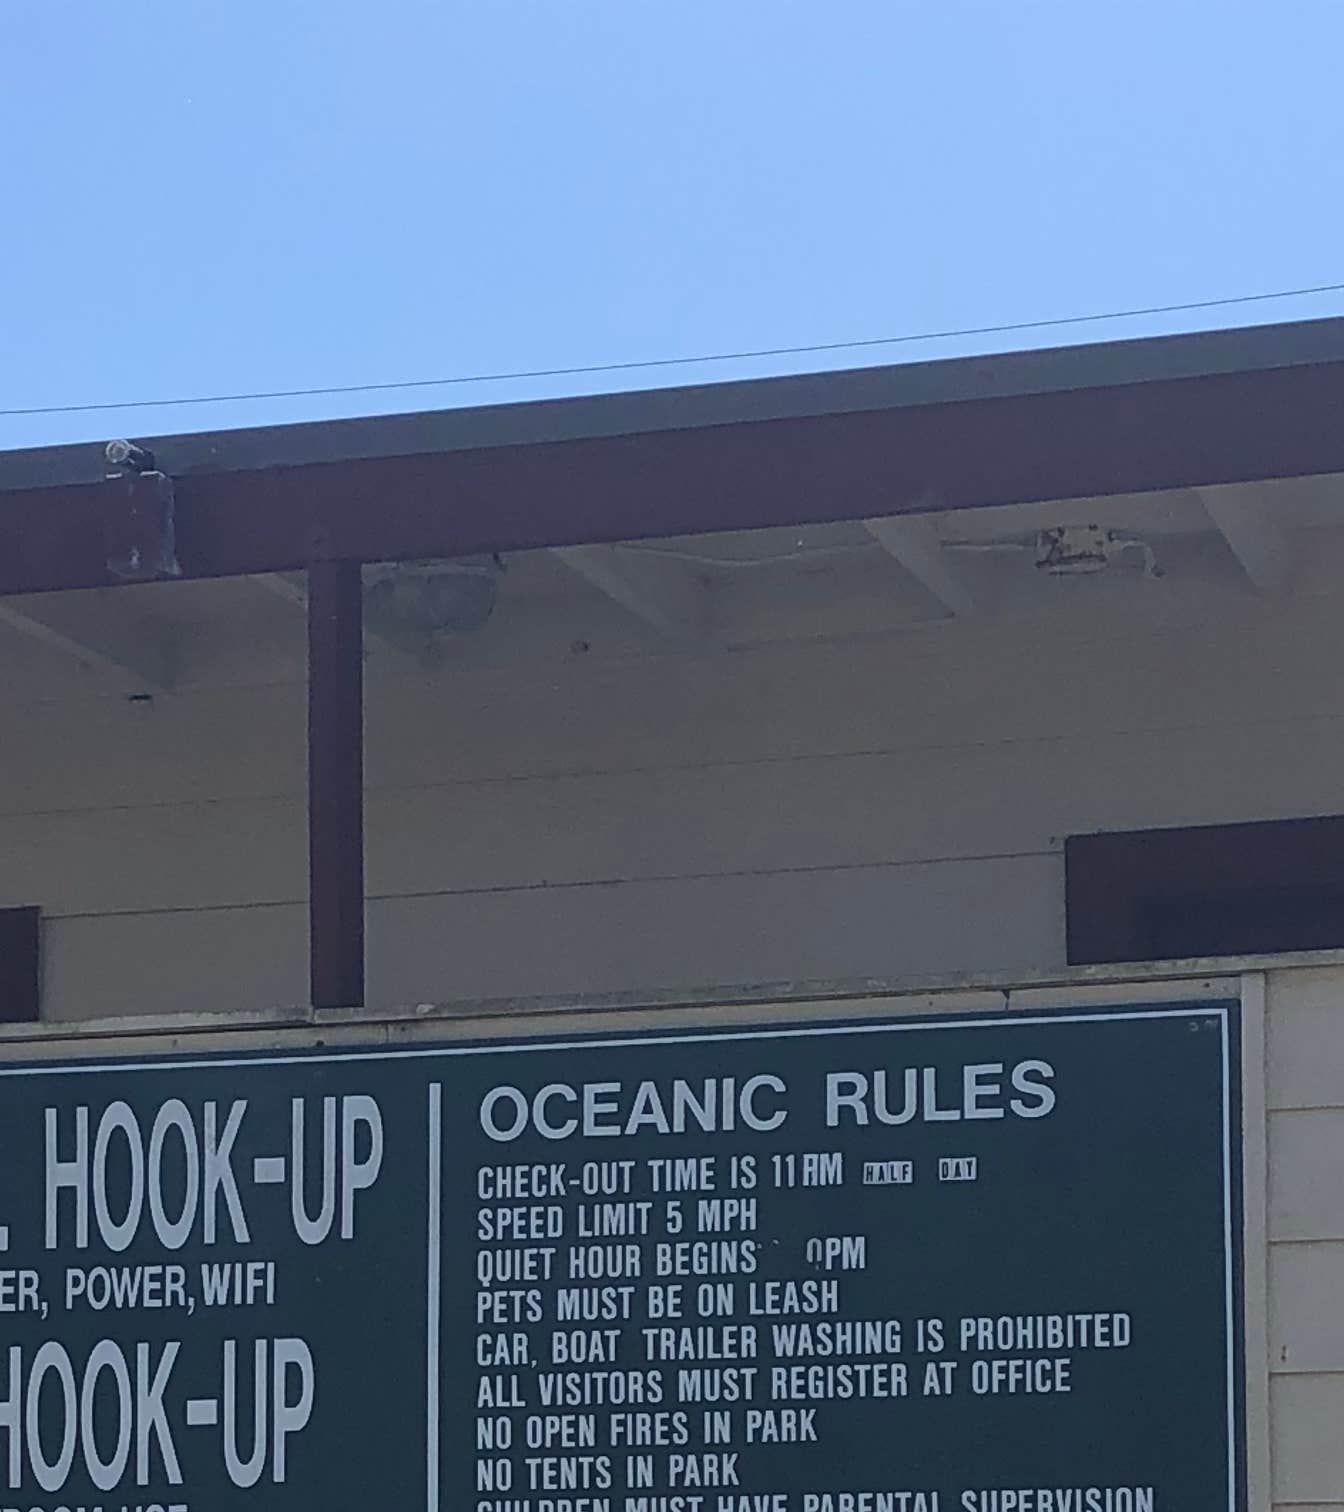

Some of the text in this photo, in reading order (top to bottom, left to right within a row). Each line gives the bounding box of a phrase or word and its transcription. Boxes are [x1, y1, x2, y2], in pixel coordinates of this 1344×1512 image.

[481, 1060, 1055, 1141] OCEANIC RULES
[46, 1096, 383, 1251] HOOK-UP
[479, 1161, 635, 1199] CHECK-OUT
[648, 1157, 714, 1191] TIME
[732, 1156, 756, 1188] IS
[939, 1157, 977, 1181] DAY
[478, 1199, 756, 1240] SPEED LIMIT 5 MPH
[202, 1262, 274, 1305] WIFI
[478, 1248, 556, 1287] QUIET
[570, 1245, 640, 1278] HOUR
[657, 1240, 756, 1275] BEGINS
[478, 1281, 837, 1323] PETS MUST BE ON LEASH
[477, 1314, 1129, 1368] CAR, BOAT TRAILER WASHING IS PROHIBITED
[478, 1359, 1070, 1408] ALL VISITORS MUST REGISTER AT OFFICE
[478, 1409, 817, 1449] NO OPEN FIRES IN PARK
[478, 1454, 739, 1491] NO TENTS IN PARK
